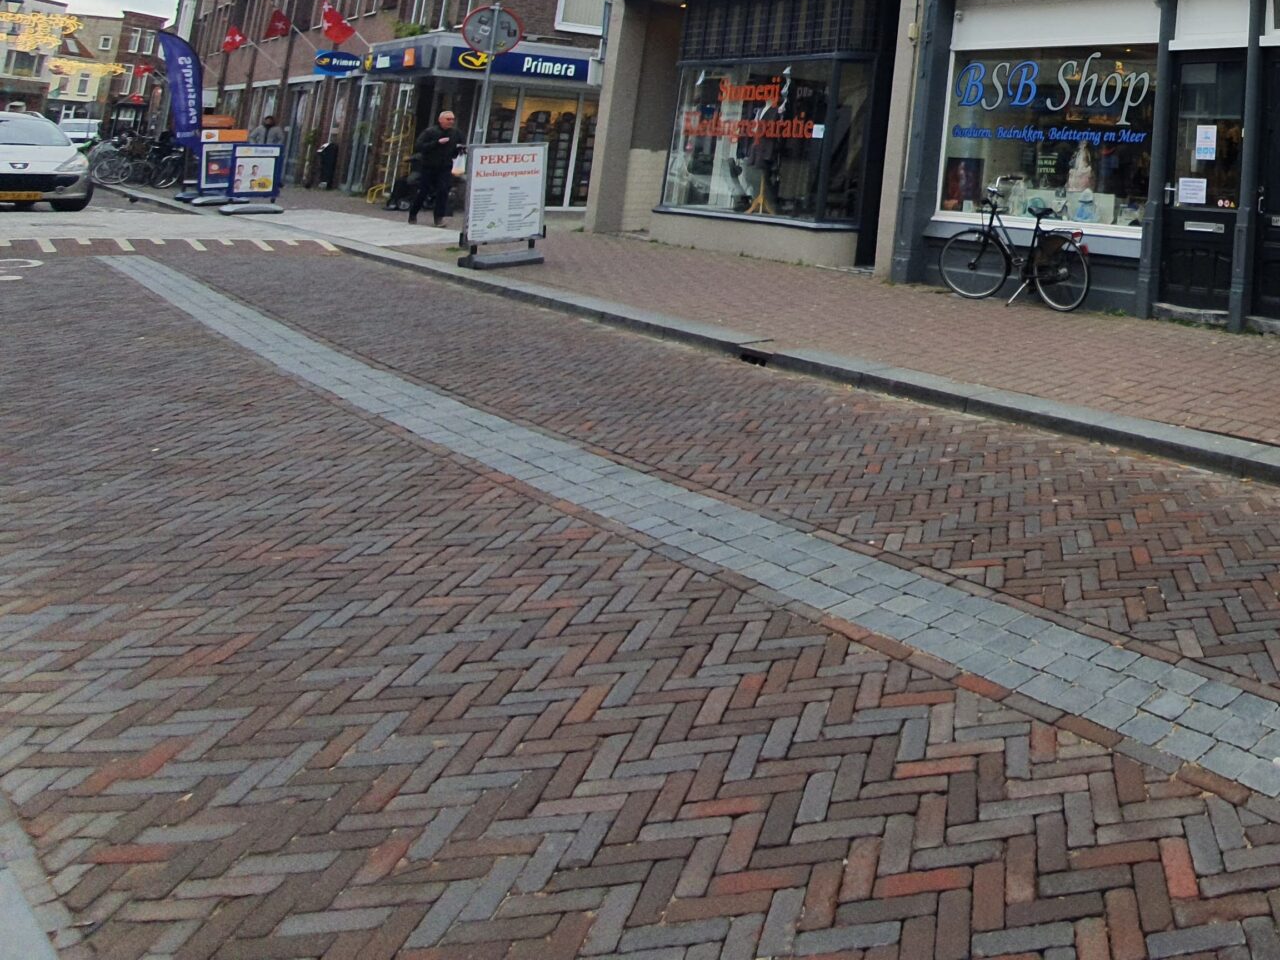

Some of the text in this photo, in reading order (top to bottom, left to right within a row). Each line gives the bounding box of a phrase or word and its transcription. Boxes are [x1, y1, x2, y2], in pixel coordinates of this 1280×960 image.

[332, 57, 361, 67] Primera
[522, 56, 576, 77] Primera
[718, 76, 783, 107] Stomerij
[956, 51, 1151, 127] BSB Shop
[1049, 126, 1101, 146] Belettering
[1103, 132, 1116, 142] en
[1117, 129, 1147, 144] Meer
[480, 152, 538, 165] PERFECT
